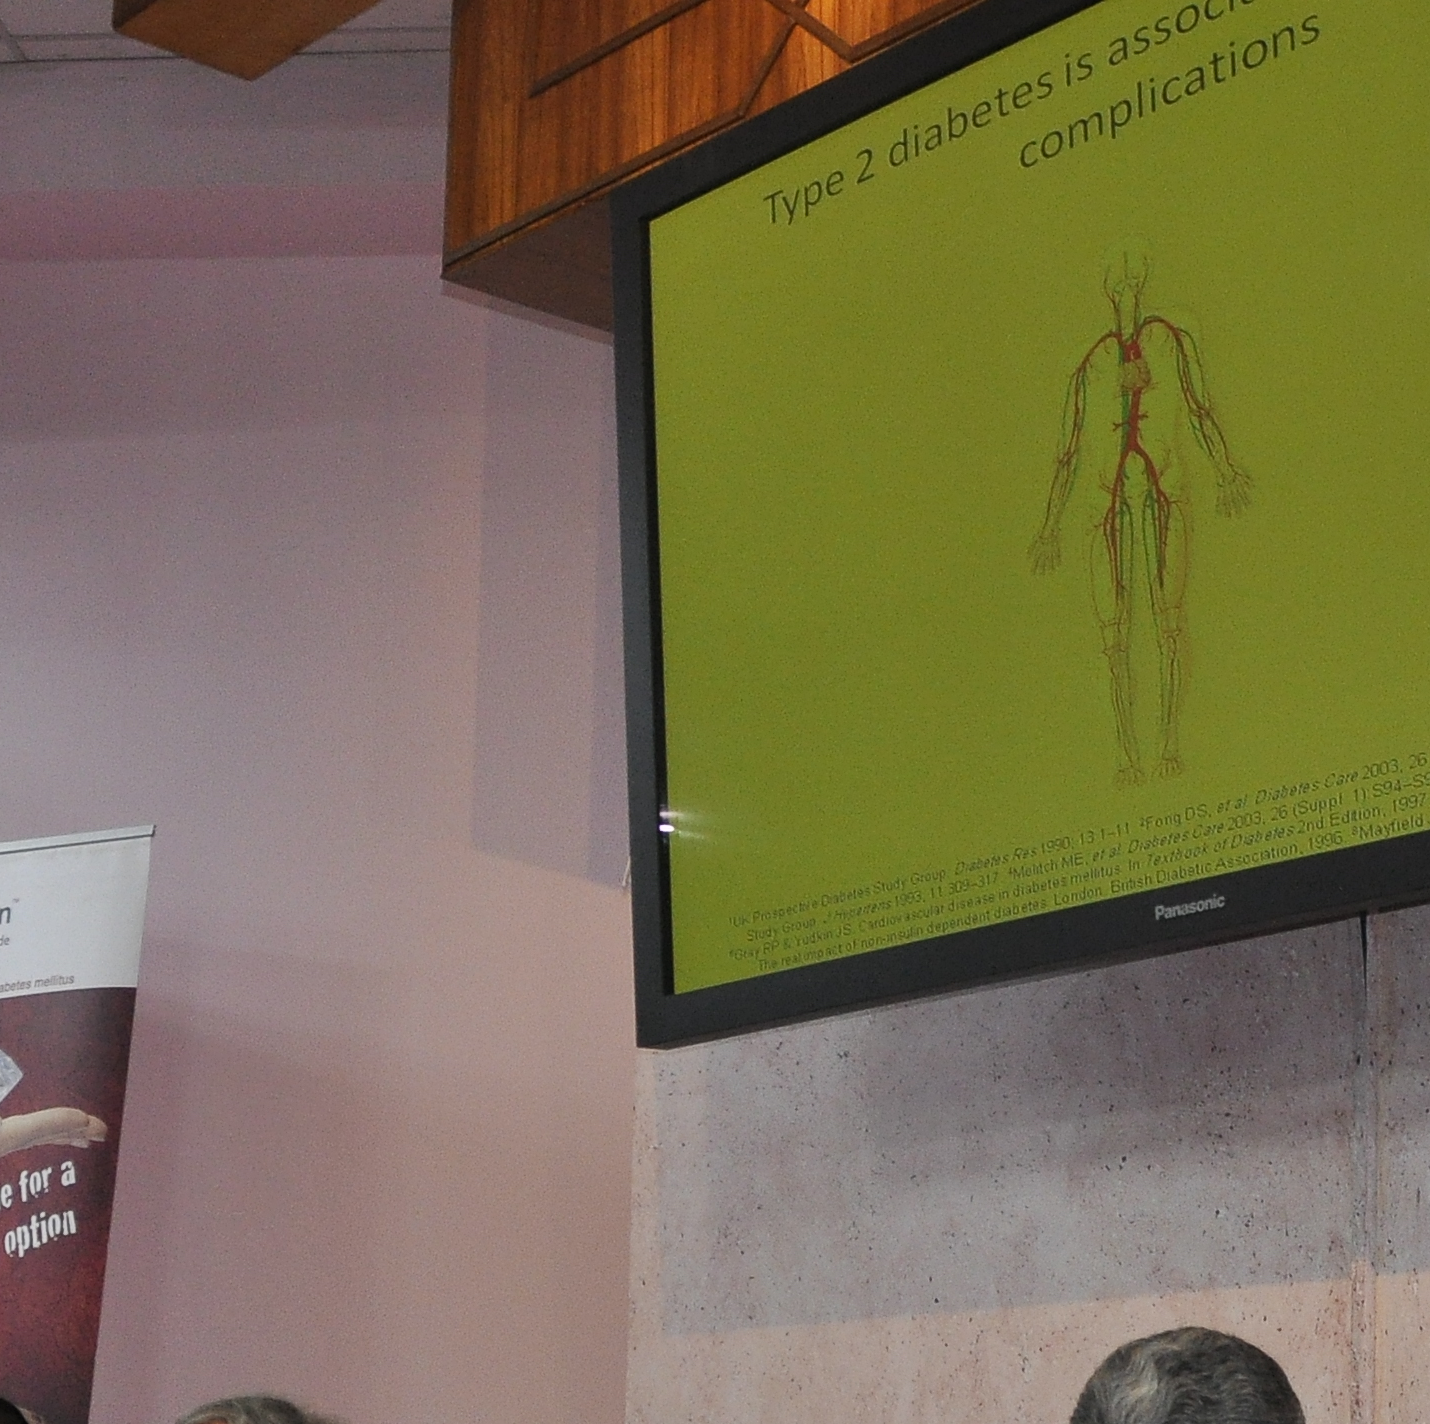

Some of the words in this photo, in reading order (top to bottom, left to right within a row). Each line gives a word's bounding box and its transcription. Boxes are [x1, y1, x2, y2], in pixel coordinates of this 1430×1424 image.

[763, 170, 844, 226] Type
[855, 148, 875, 185] 2
[888, 71, 1054, 168] diabetes
[1064, 52, 1094, 87] is
[1108, 0, 1254, 67] assoc
[1020, 15, 1321, 168] complications
[745, 924, 777, 941] Study
[1126, 830, 1189, 852] Diabetes
[1191, 822, 1224, 837] Care
[820, 886, 871, 906] Diabetes
[871, 877, 906, 894] Study
[953, 854, 1009, 875] Diabetes
[1254, 780, 1320, 804] Diabetes
[1322, 771, 1359, 788] Care
[946, 893, 995, 912] disease
[1011, 876, 1066, 897] diabetes
[1145, 841, 1208, 867] Textbook
[1229, 825, 1295, 848] Diabetes
[1296, 815, 1324, 833] 2nd
[757, 957, 778, 971] The
[780, 950, 801, 966] real
[802, 941, 843, 962] impact
[925, 908, 991, 935] dependent
[1109, 872, 1152, 894] British
[1155, 861, 1212, 883] Diabetic
[1154, 893, 1226, 921] Panasonic
[34, 974, 76, 989] mellitus
[19, 1166, 53, 1203] for
[60, 1160, 76, 1187] a
[4, 1210, 77, 1258] option
